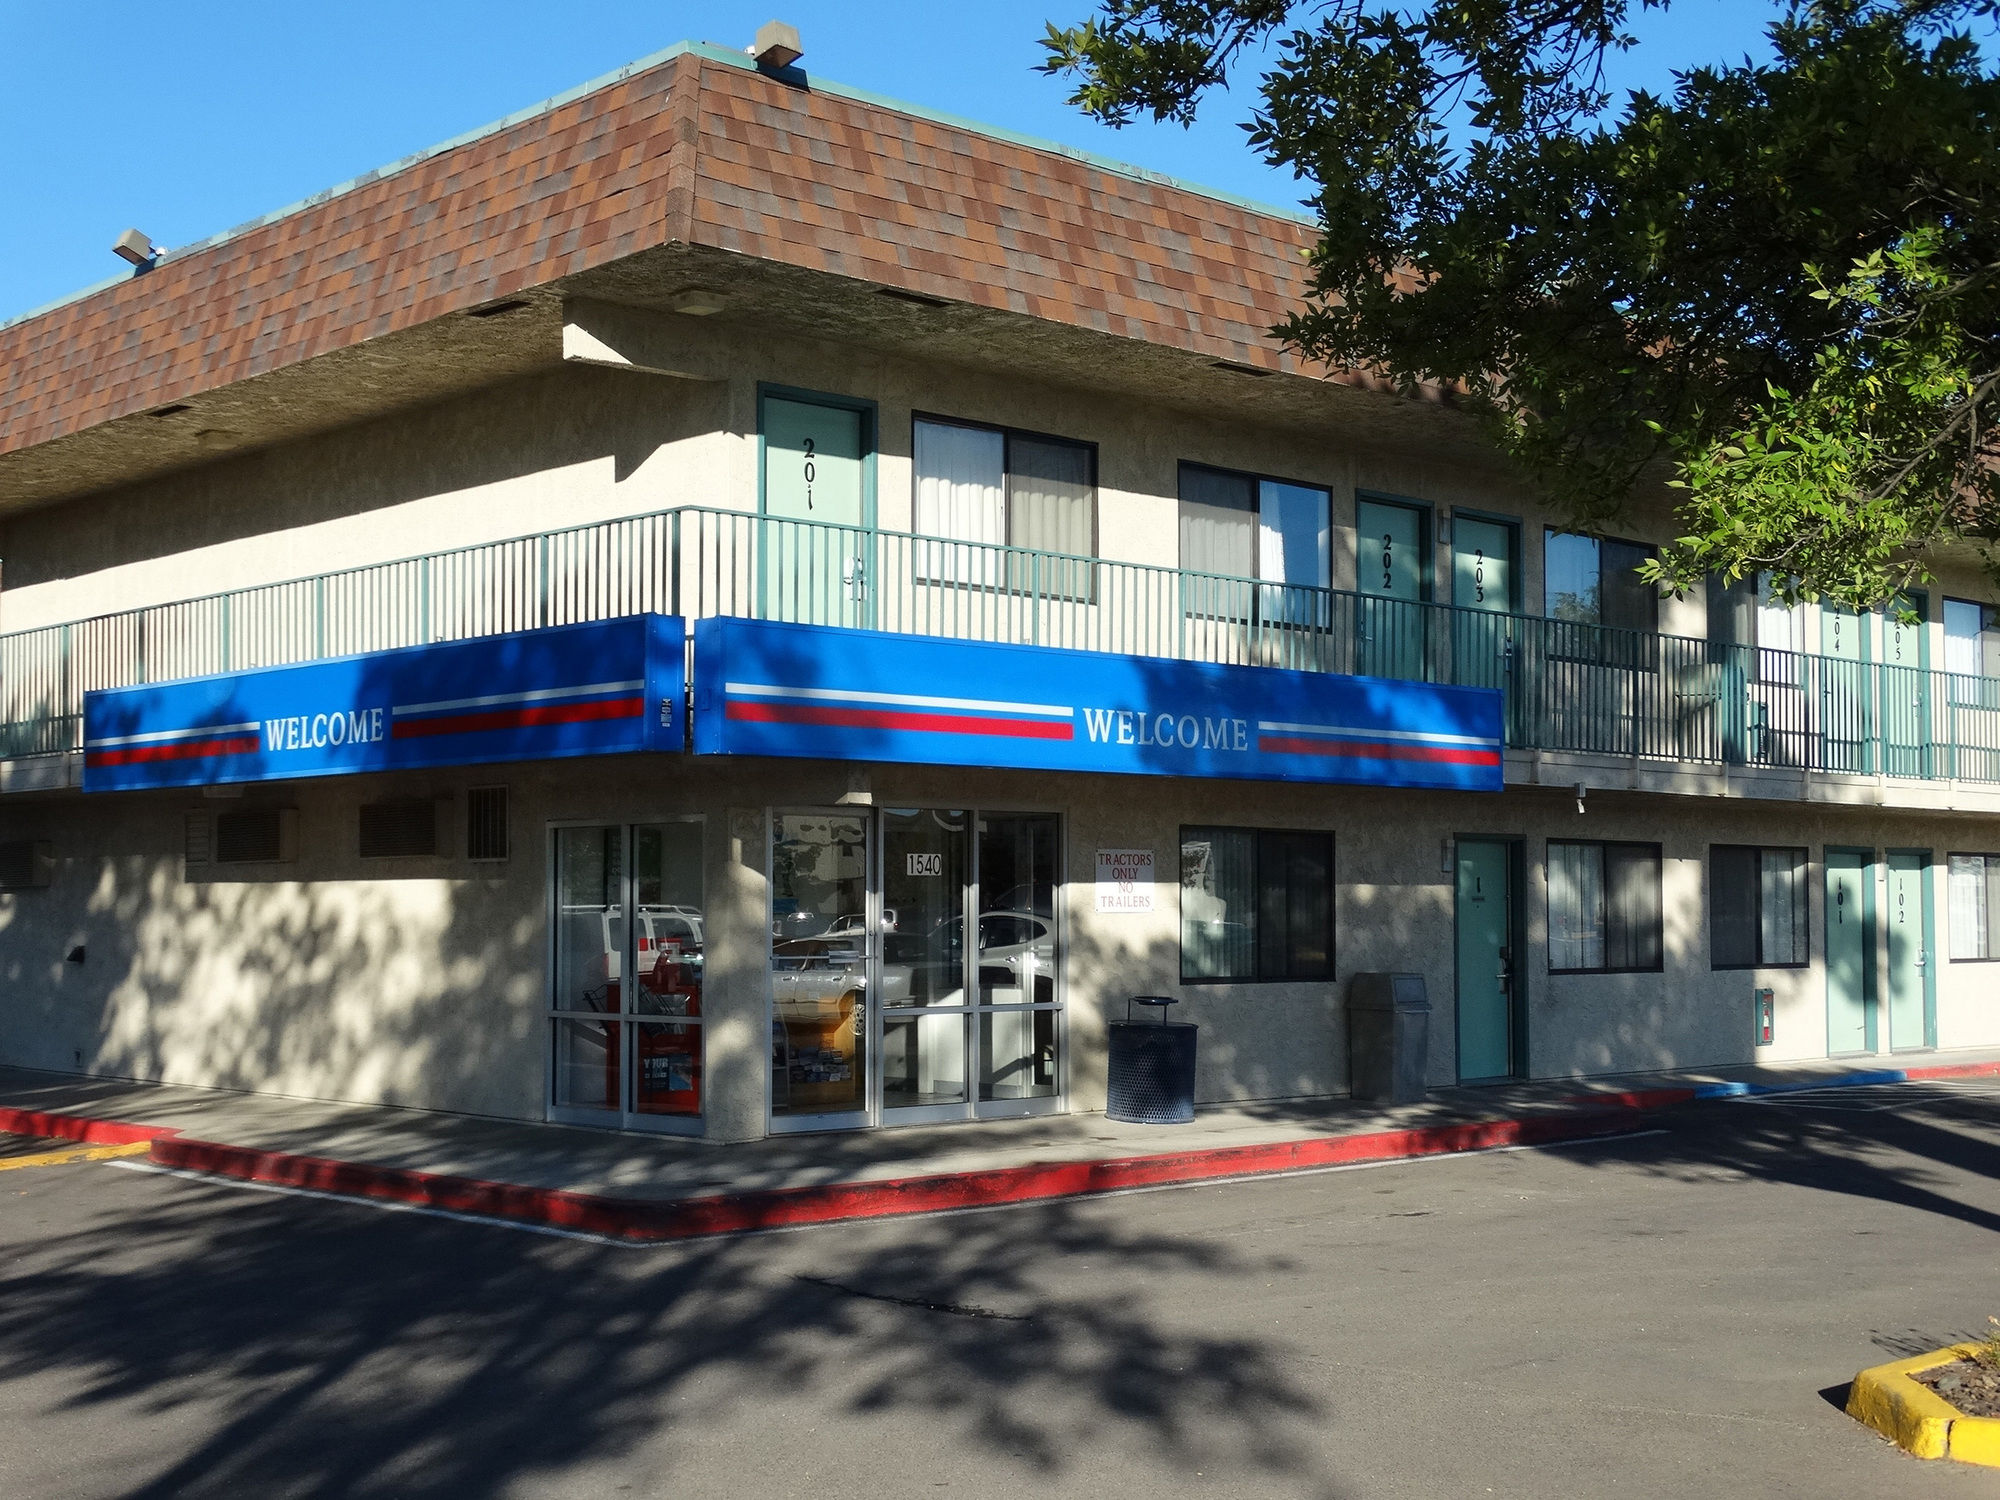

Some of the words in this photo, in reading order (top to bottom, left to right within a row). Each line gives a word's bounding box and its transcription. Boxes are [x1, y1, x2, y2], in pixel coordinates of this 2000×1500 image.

[803, 438, 815, 510] 201
[1383, 534, 1392, 589] 202
[1475, 549, 1484, 602] 203
[265, 708, 384, 752] WELCOME
[1082, 707, 1248, 751] WELCOME
[909, 854, 941, 874] 1540
[1098, 853, 1152, 866] TRACTORS
[1112, 867, 1139, 880] ONLY
[1101, 895, 1151, 908] TRAILERS
[1118, 881, 1134, 894] NO
